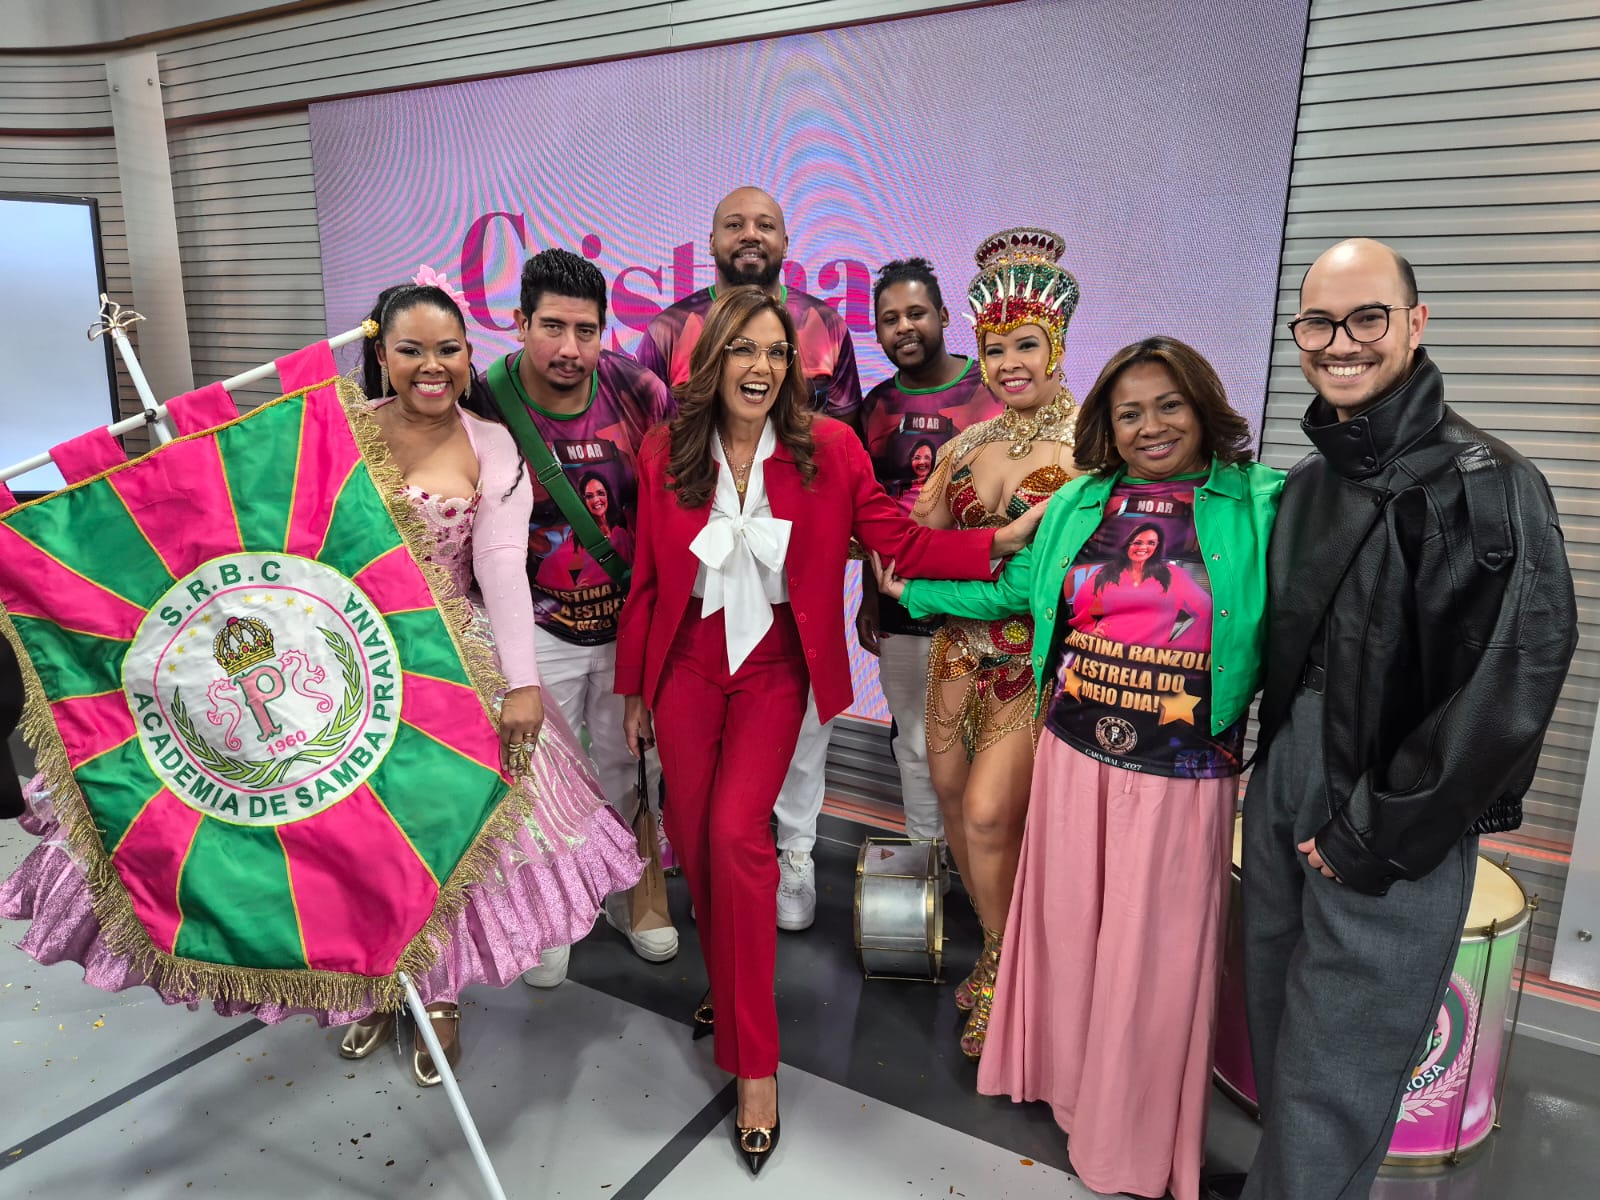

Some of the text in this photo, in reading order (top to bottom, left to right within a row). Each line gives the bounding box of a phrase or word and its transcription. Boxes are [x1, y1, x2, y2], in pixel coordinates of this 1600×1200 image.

[912, 416, 939, 429] NO AR
[566, 443, 604, 460] NO AR
[1137, 500, 1174, 514] NO AR
[1073, 654, 1186, 693] A ESTRELA DO
[133, 592, 395, 818] ACADEMIA DE SAMBA PRAIANA
[1081, 680, 1160, 713] MEIO DIA!
[266, 730, 307, 756] 1960
[1122, 761, 1142, 771] 2027
